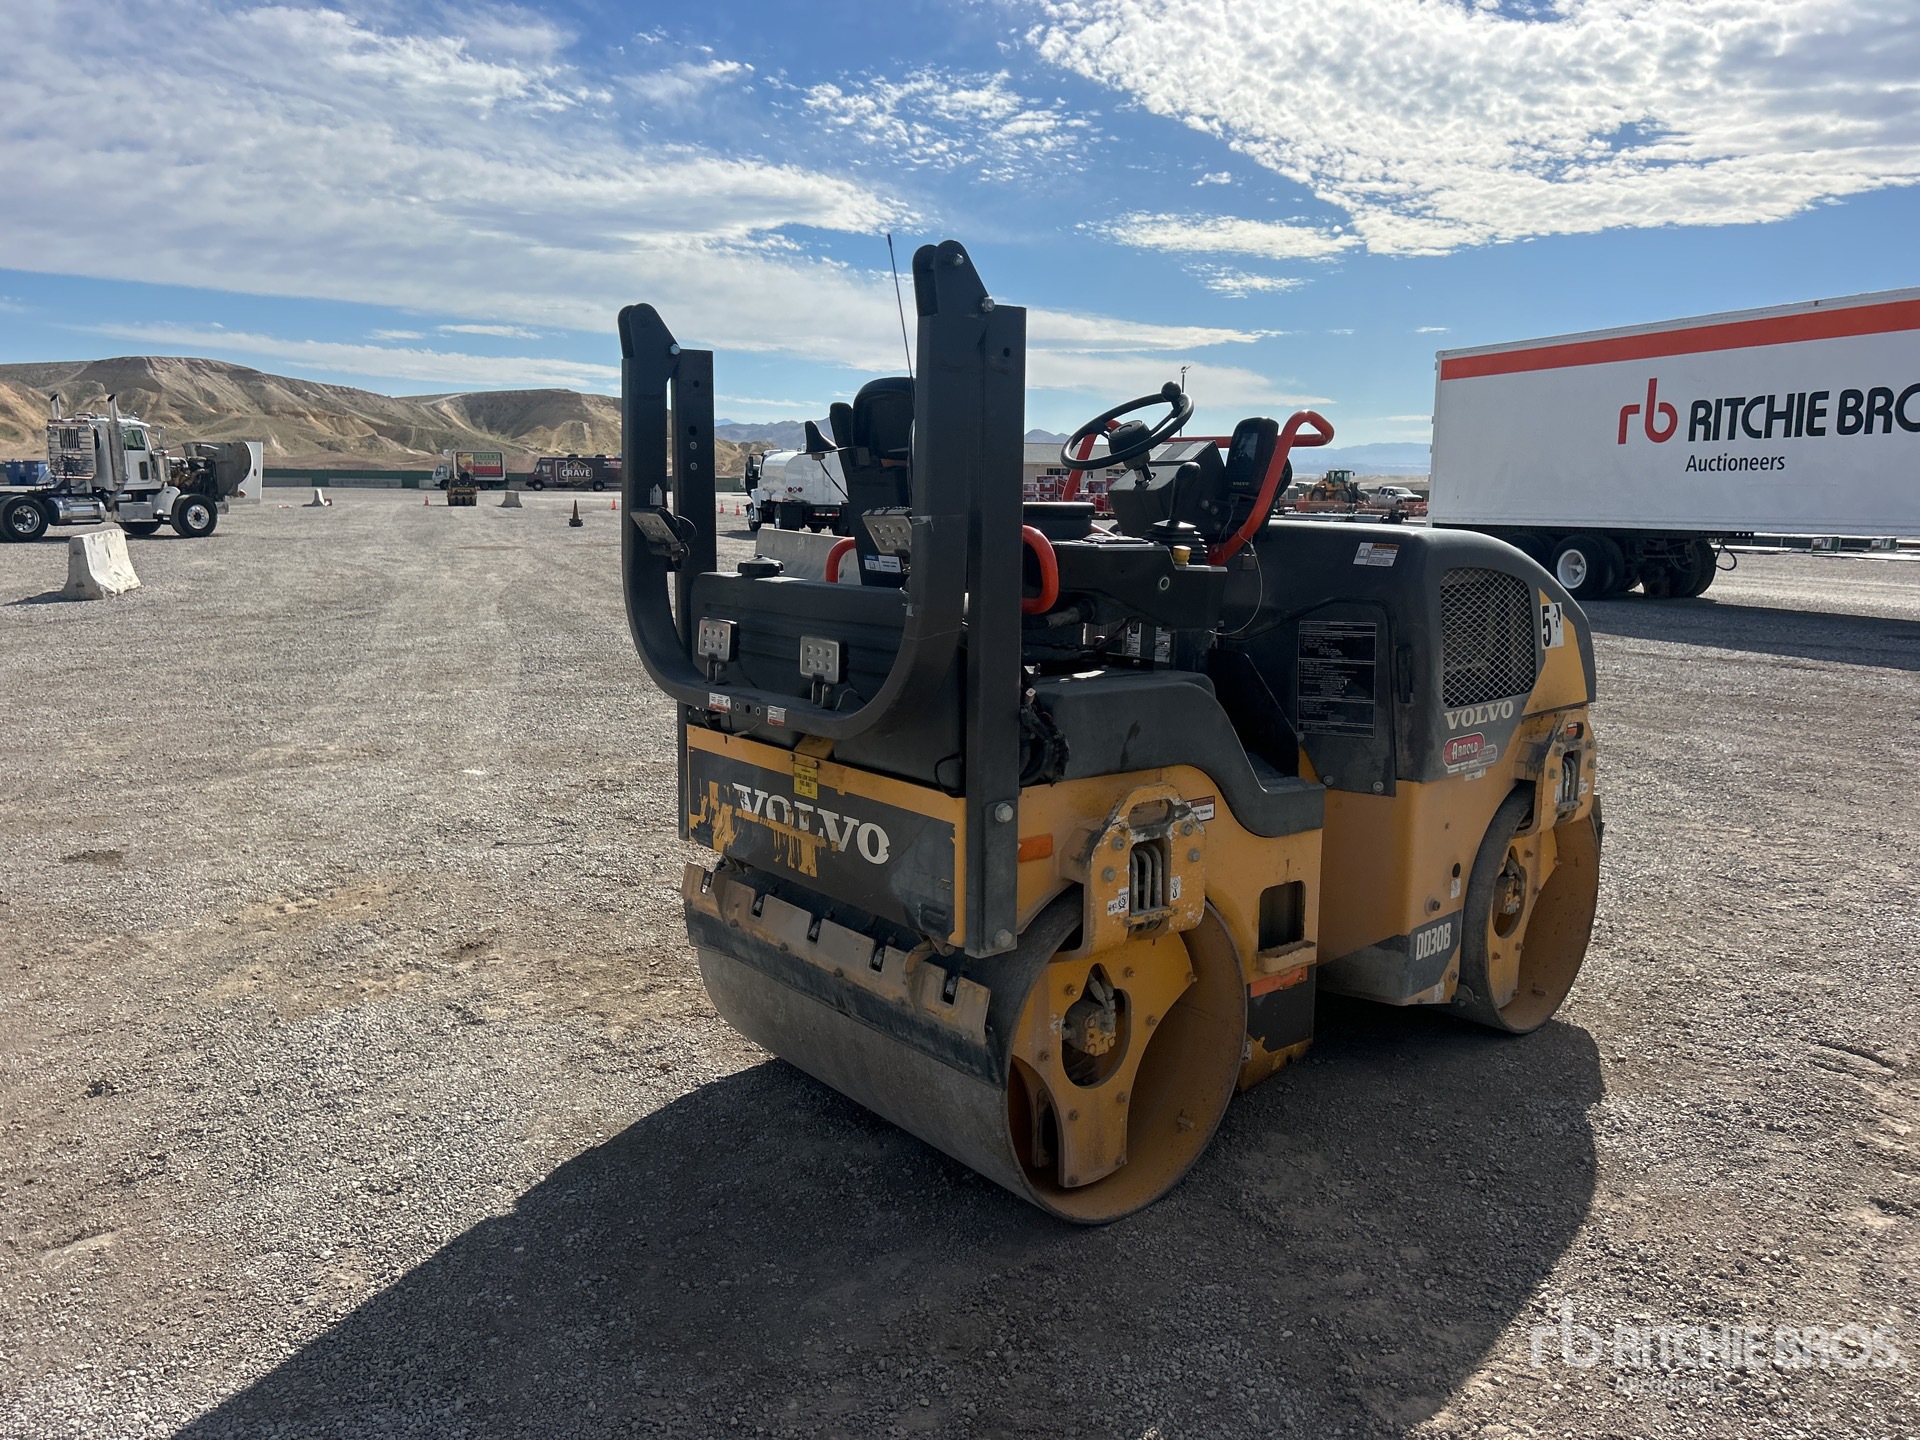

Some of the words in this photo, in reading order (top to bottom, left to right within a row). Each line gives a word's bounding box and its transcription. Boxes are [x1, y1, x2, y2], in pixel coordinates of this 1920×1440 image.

[1617, 377, 1679, 445] rb
[1688, 390, 1830, 442] RITCHIE
[561, 469, 591, 477] CRAVE
[1685, 453, 1786, 473] Auctioneers
[1444, 700, 1514, 730] VOLVO
[732, 782, 891, 865] VOLVO
[1415, 922, 1452, 961] DD30B
